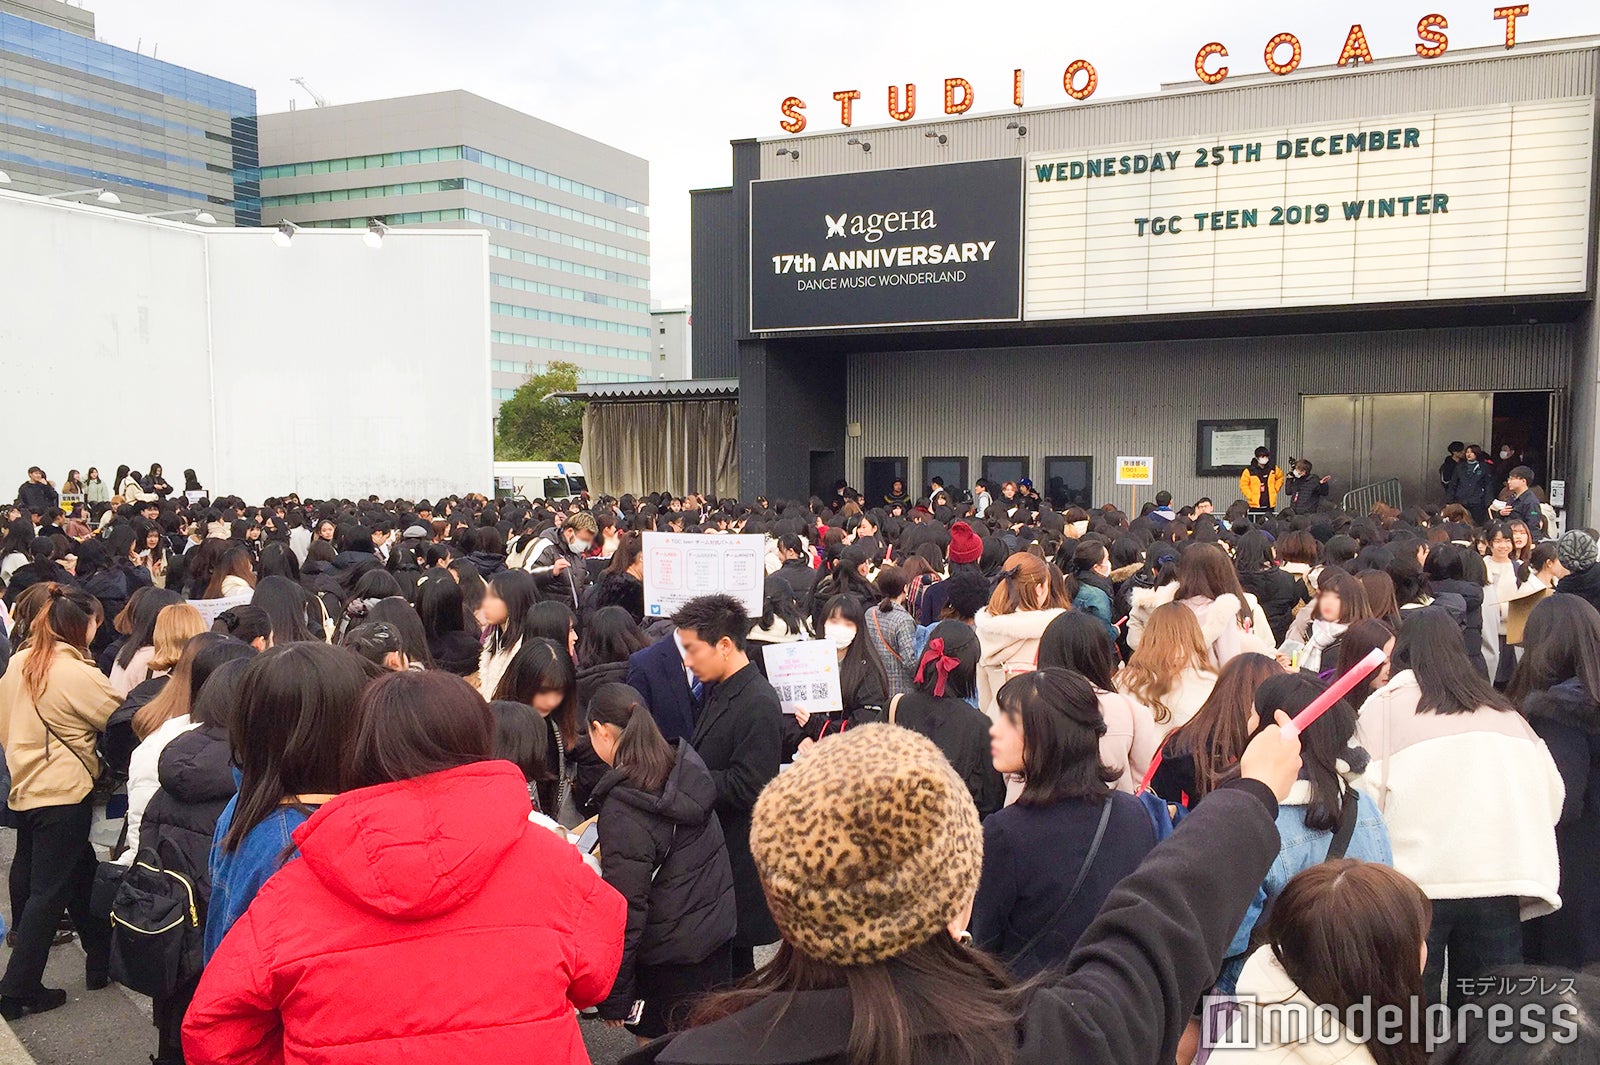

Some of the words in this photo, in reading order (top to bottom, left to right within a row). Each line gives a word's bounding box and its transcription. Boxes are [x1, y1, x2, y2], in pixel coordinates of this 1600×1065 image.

[780, 59, 1098, 134] STUDIO
[1194, 4, 1530, 84] COAST
[1035, 150, 1181, 182] WEDNESDAY
[1194, 142, 1262, 168] 25TH
[1276, 127, 1420, 160] DECEMBER
[1134, 215, 1182, 237] TGC
[1194, 208, 1258, 231] TEEN
[1269, 203, 1330, 226] 2019
[1342, 193, 1449, 221] WINTER
[772, 253, 816, 274] 17th
[822, 240, 996, 272] ANNIVERSARY
[797, 277, 837, 291] DANCE
[839, 275, 877, 289] MUSIC
[879, 270, 967, 287] WONDERLAND
